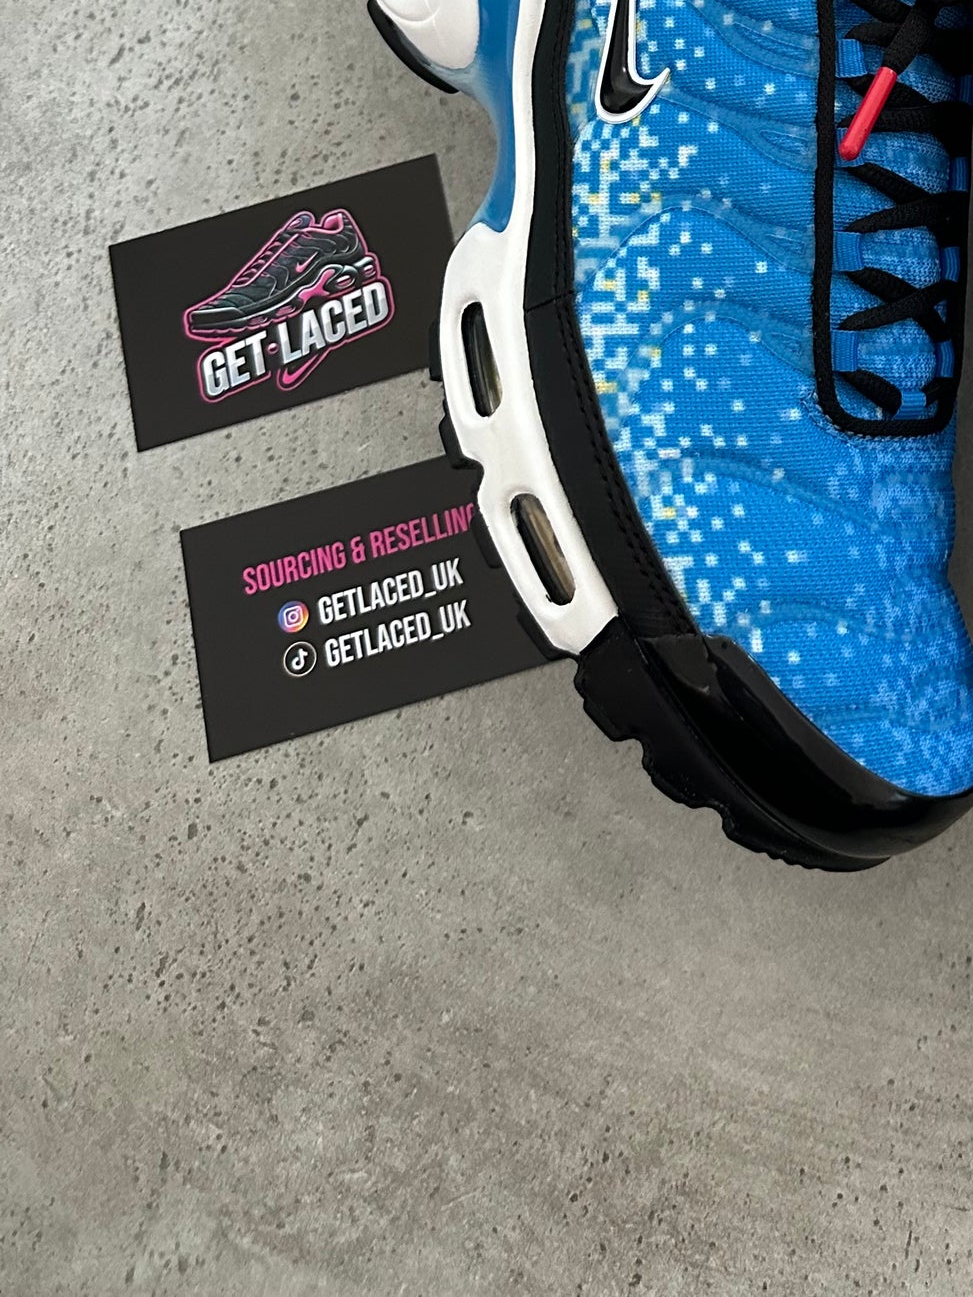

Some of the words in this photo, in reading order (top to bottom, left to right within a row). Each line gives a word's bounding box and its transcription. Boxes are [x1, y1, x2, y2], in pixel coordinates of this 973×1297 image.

[277, 282, 389, 364] LACED
[242, 542, 347, 595] SOURCING
[350, 536, 366, 564] &
[318, 558, 464, 625] GETLACED_UK
[325, 600, 472, 668] GETLACED_UK
